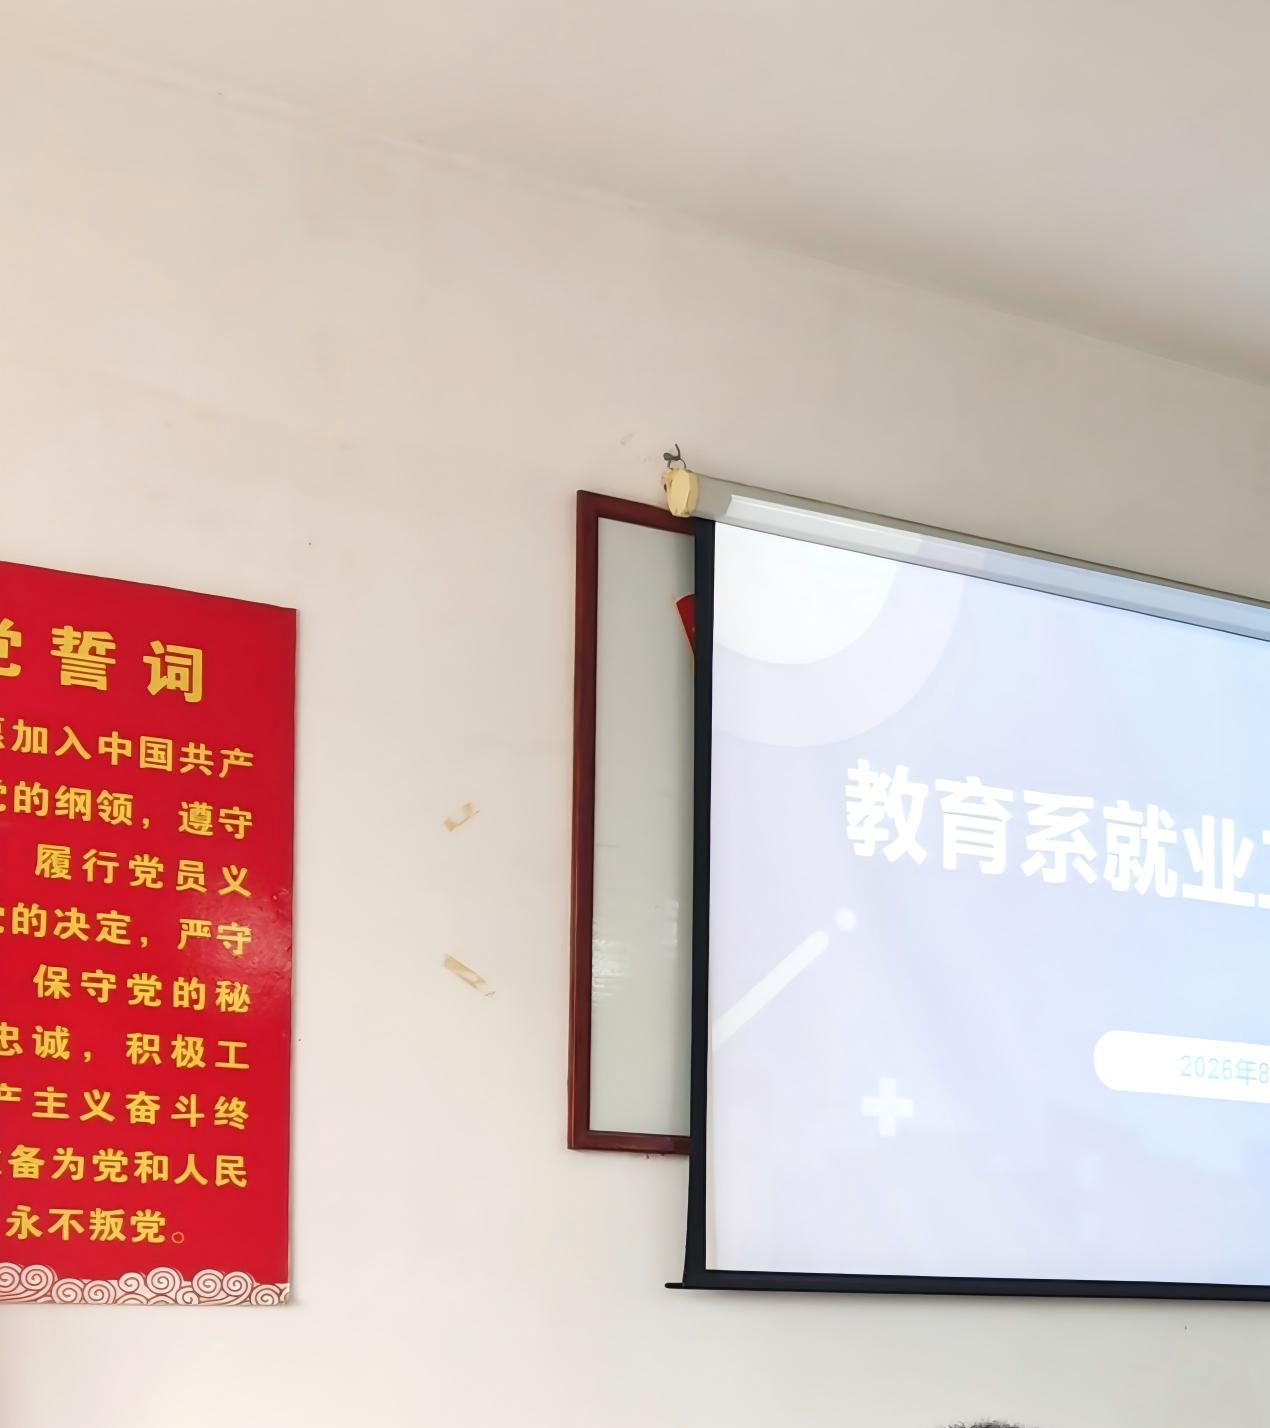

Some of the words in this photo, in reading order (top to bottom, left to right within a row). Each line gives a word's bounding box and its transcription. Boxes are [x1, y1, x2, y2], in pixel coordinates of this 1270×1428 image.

[0, 718, 253, 778] 加入中国共产
[0, 780, 253, 840] 的纲领，遵守
[35, 844, 251, 898] 履行党员义
[0, 903, 253, 957] 的决定，严守
[33, 964, 251, 1013] 保守党的秘
[0, 1145, 247, 1188] 备为党和人民
[6, 1205, 185, 1245] 永不叛党。
